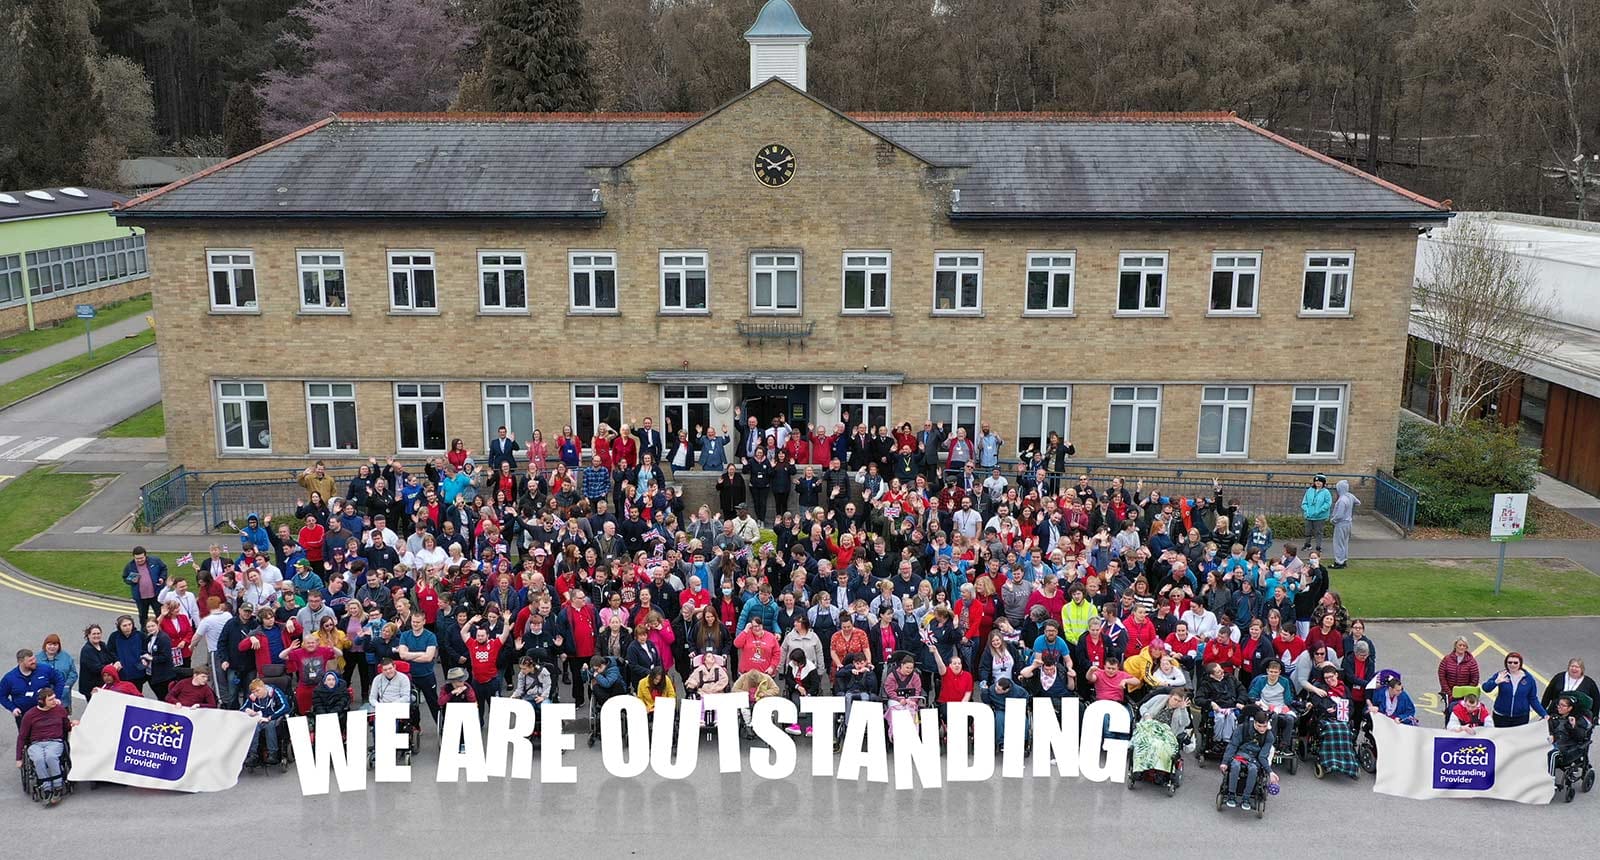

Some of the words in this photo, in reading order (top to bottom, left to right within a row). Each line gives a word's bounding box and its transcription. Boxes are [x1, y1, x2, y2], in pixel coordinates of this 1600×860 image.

[129, 725, 184, 749] Ofsted
[124, 755, 161, 770] Provider
[126, 746, 178, 765] Outstanding
[1440, 751, 1488, 765] Ofsted
[1440, 768, 1486, 778] Outstanding
[1440, 775, 1473, 784] Provider
